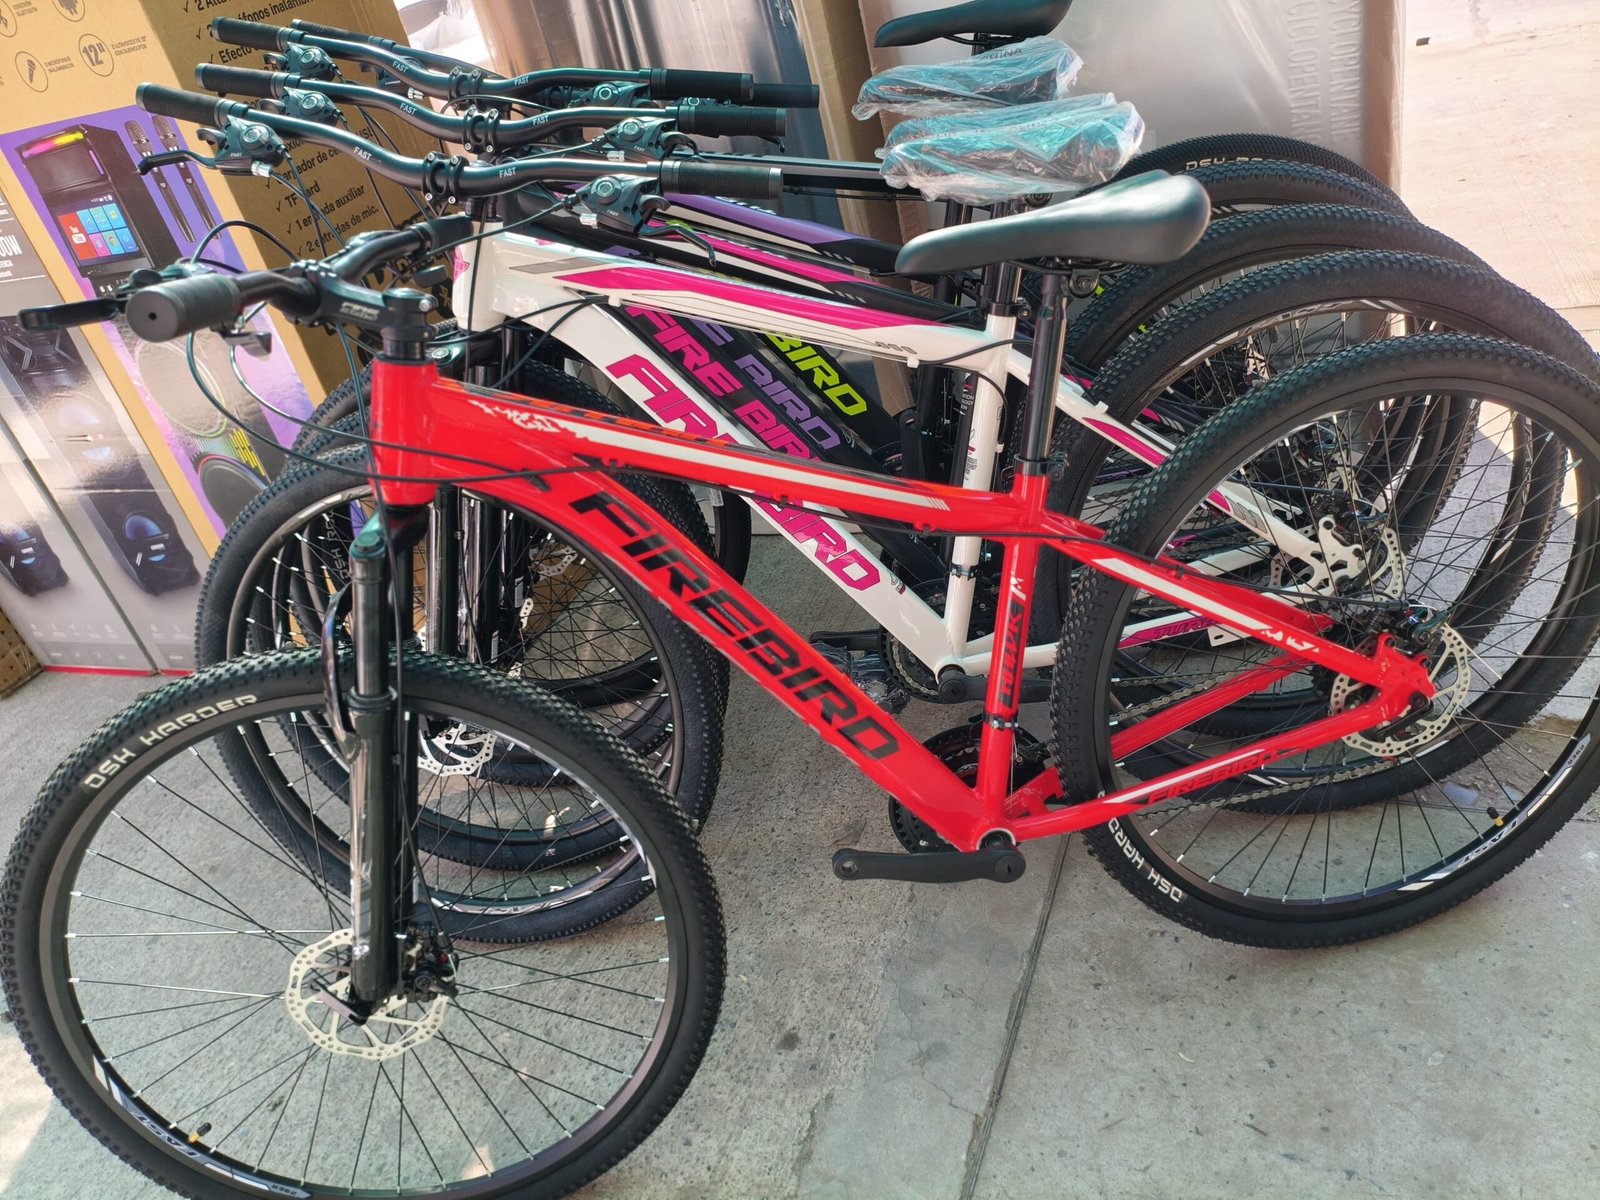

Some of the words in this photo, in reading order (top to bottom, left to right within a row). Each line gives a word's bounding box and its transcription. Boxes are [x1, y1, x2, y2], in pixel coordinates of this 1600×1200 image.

[392, 61, 408, 73] FAST
[514, 76, 529, 86] FAST
[400, 102, 417, 115] FAST
[533, 115, 549, 126] FAST
[353, 146, 372, 161] FAST
[499, 167, 516, 178] FAST
[304, 180, 321, 198] ard
[336, 184, 366, 208] auxiliar
[350, 214, 362, 226] de
[605, 354, 740, 445] FIR
[732, 399, 822, 462] BIR
[569, 490, 900, 761] FIREBIRD
[84, 747, 136, 789] DSH
[139, 694, 258, 746] HARDER
[1148, 750, 1278, 804] FIREBIRD
[1147, 867, 1183, 903] DSH
